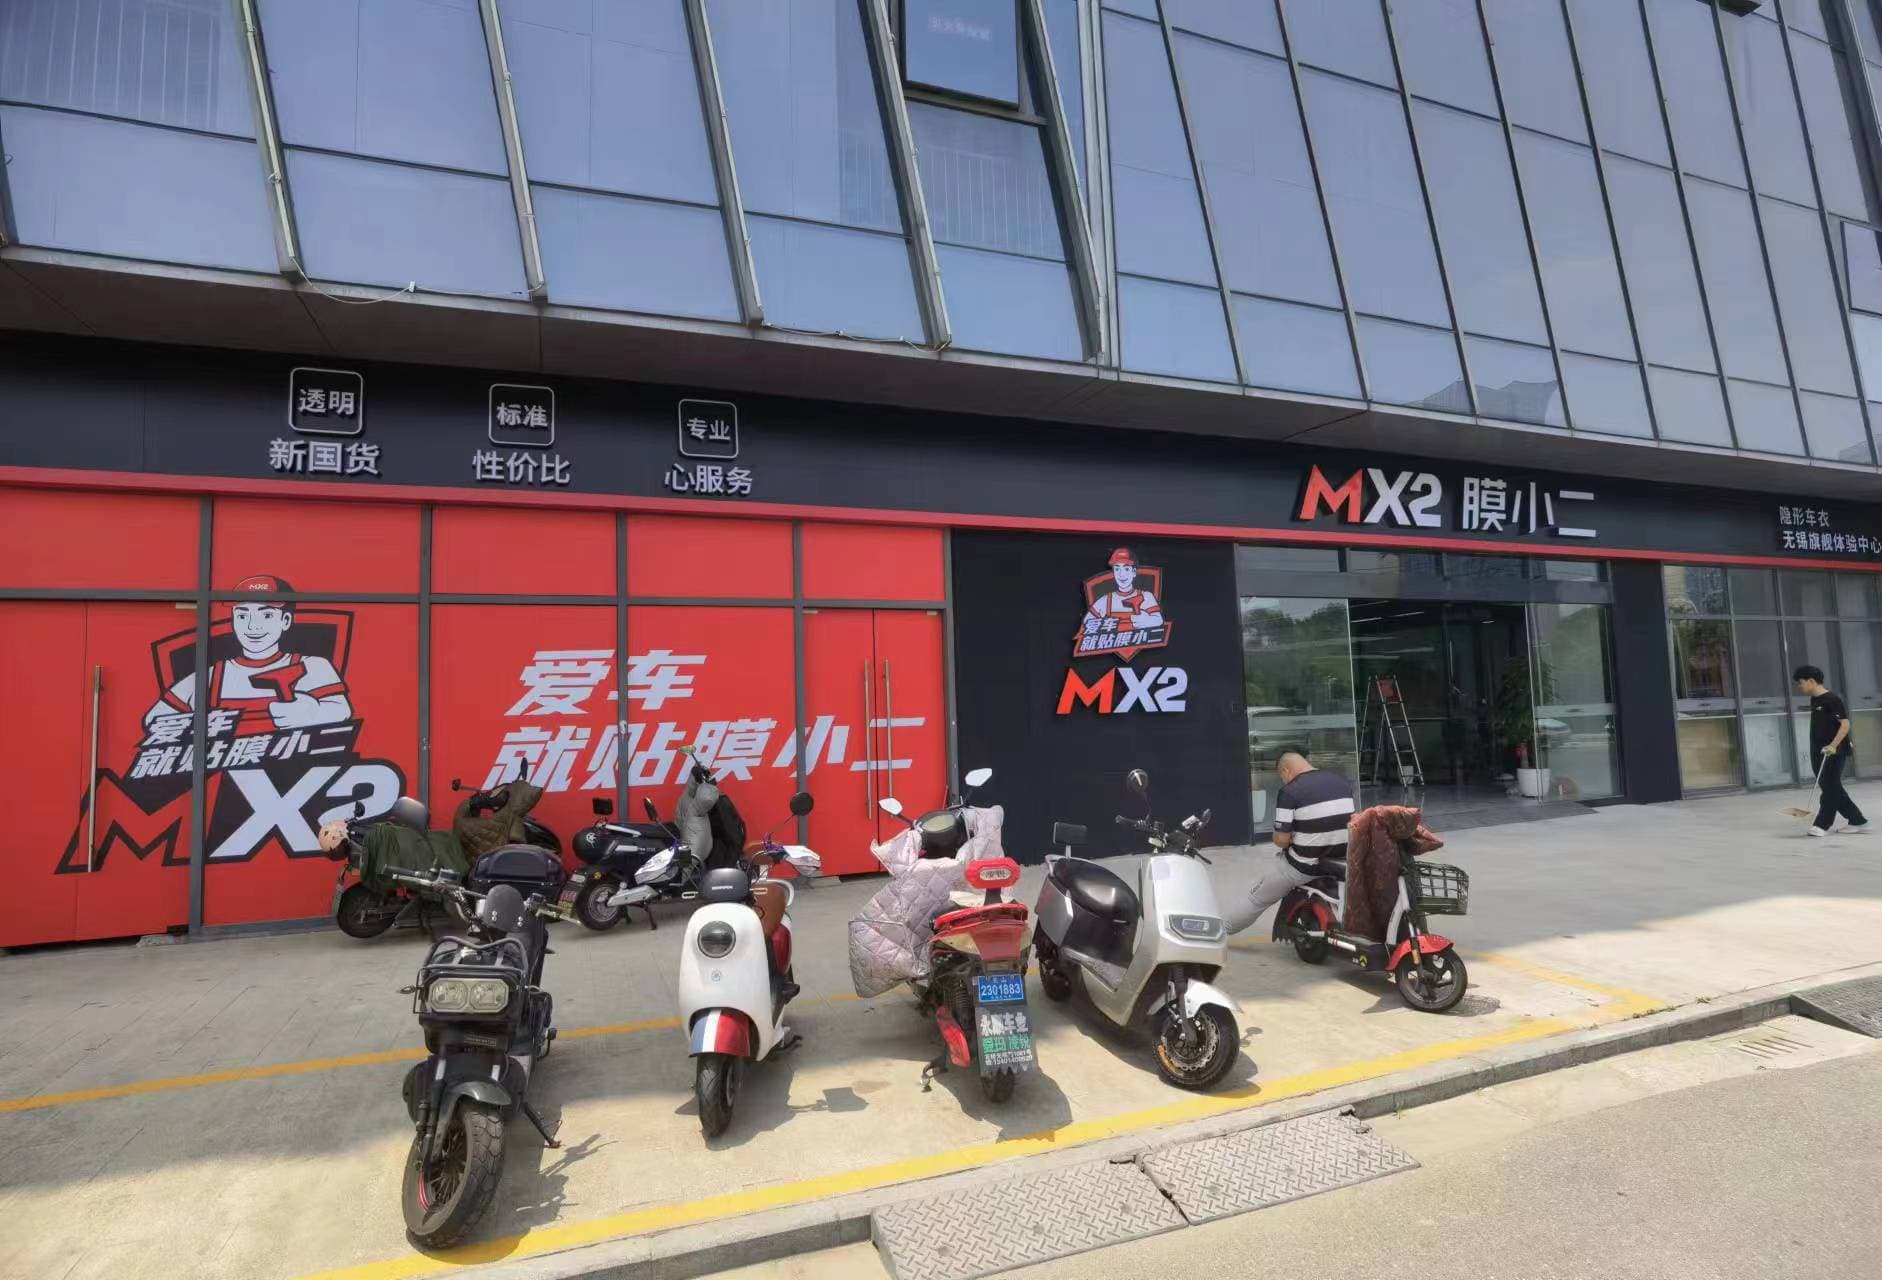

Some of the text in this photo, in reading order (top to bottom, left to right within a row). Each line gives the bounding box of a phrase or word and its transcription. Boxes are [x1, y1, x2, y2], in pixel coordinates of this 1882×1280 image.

[299, 388, 356, 417] 透明
[496, 403, 549, 429] 标准
[686, 418, 731, 441] 专业
[269, 438, 381, 475] 新国货
[472, 450, 571, 484] 性价比
[664, 465, 753, 496] 心服务
[1300, 464, 1597, 537] MX2 膜小二
[1780, 506, 1830, 527] 隐形车衣
[1783, 530, 1882, 554] 无锡旗舰体验中心
[1080, 629, 1164, 650] 就贴膜小二
[1084, 618, 1117, 634] 爱车
[504, 649, 707, 716] 爱车
[1056, 667, 1188, 714] MX2
[142, 709, 240, 746] 爱车
[130, 726, 354, 779] 就贴膜小二
[482, 715, 926, 793] 就贴膜小二
[980, 983, 1020, 996] 2301883
